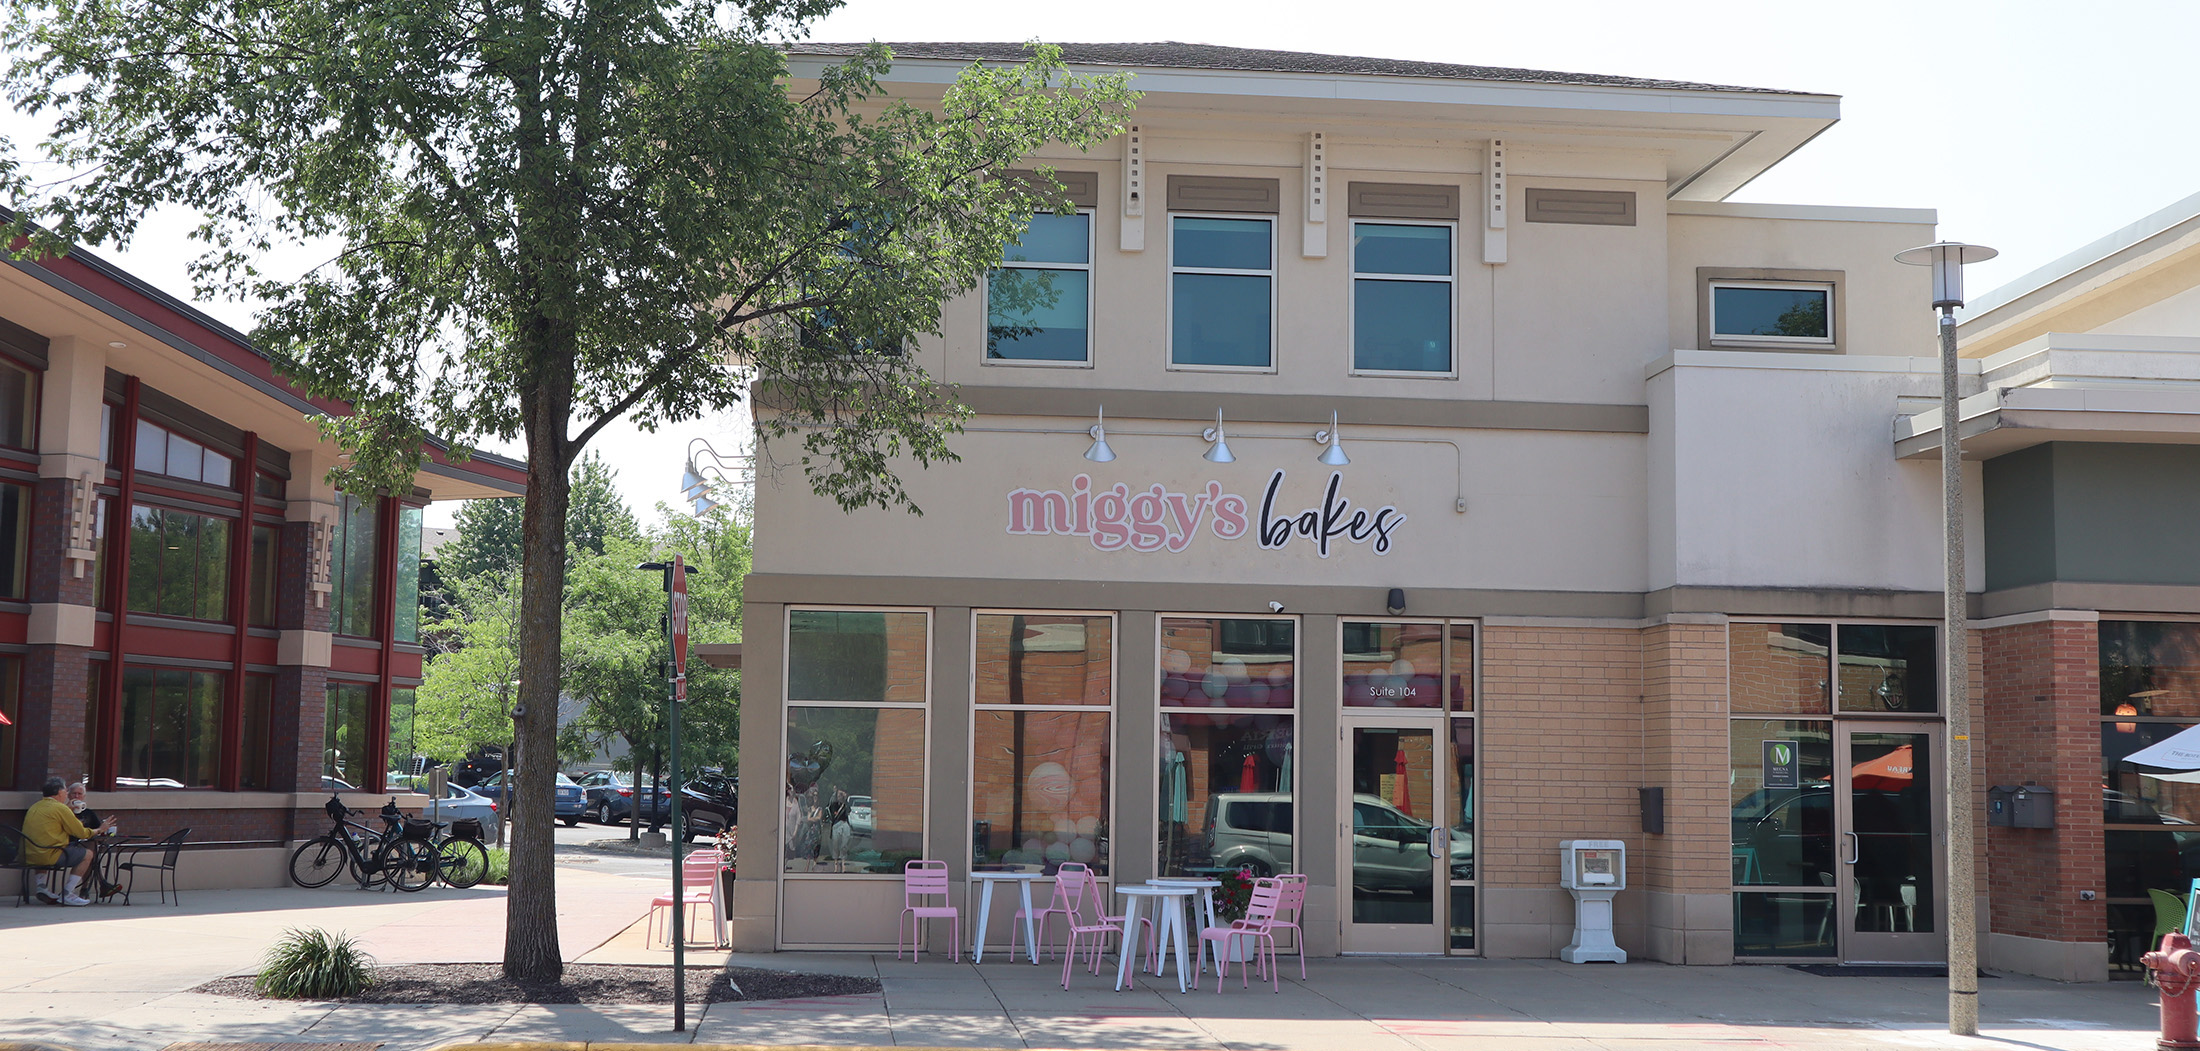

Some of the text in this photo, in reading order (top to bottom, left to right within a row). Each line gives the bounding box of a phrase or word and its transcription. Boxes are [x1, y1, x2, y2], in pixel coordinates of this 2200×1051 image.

[1008, 471, 1404, 556] miggy's bakes
[673, 591, 687, 636] STOP
[1369, 686, 1417, 697] Suite 104
[1775, 747, 1790, 764] M
